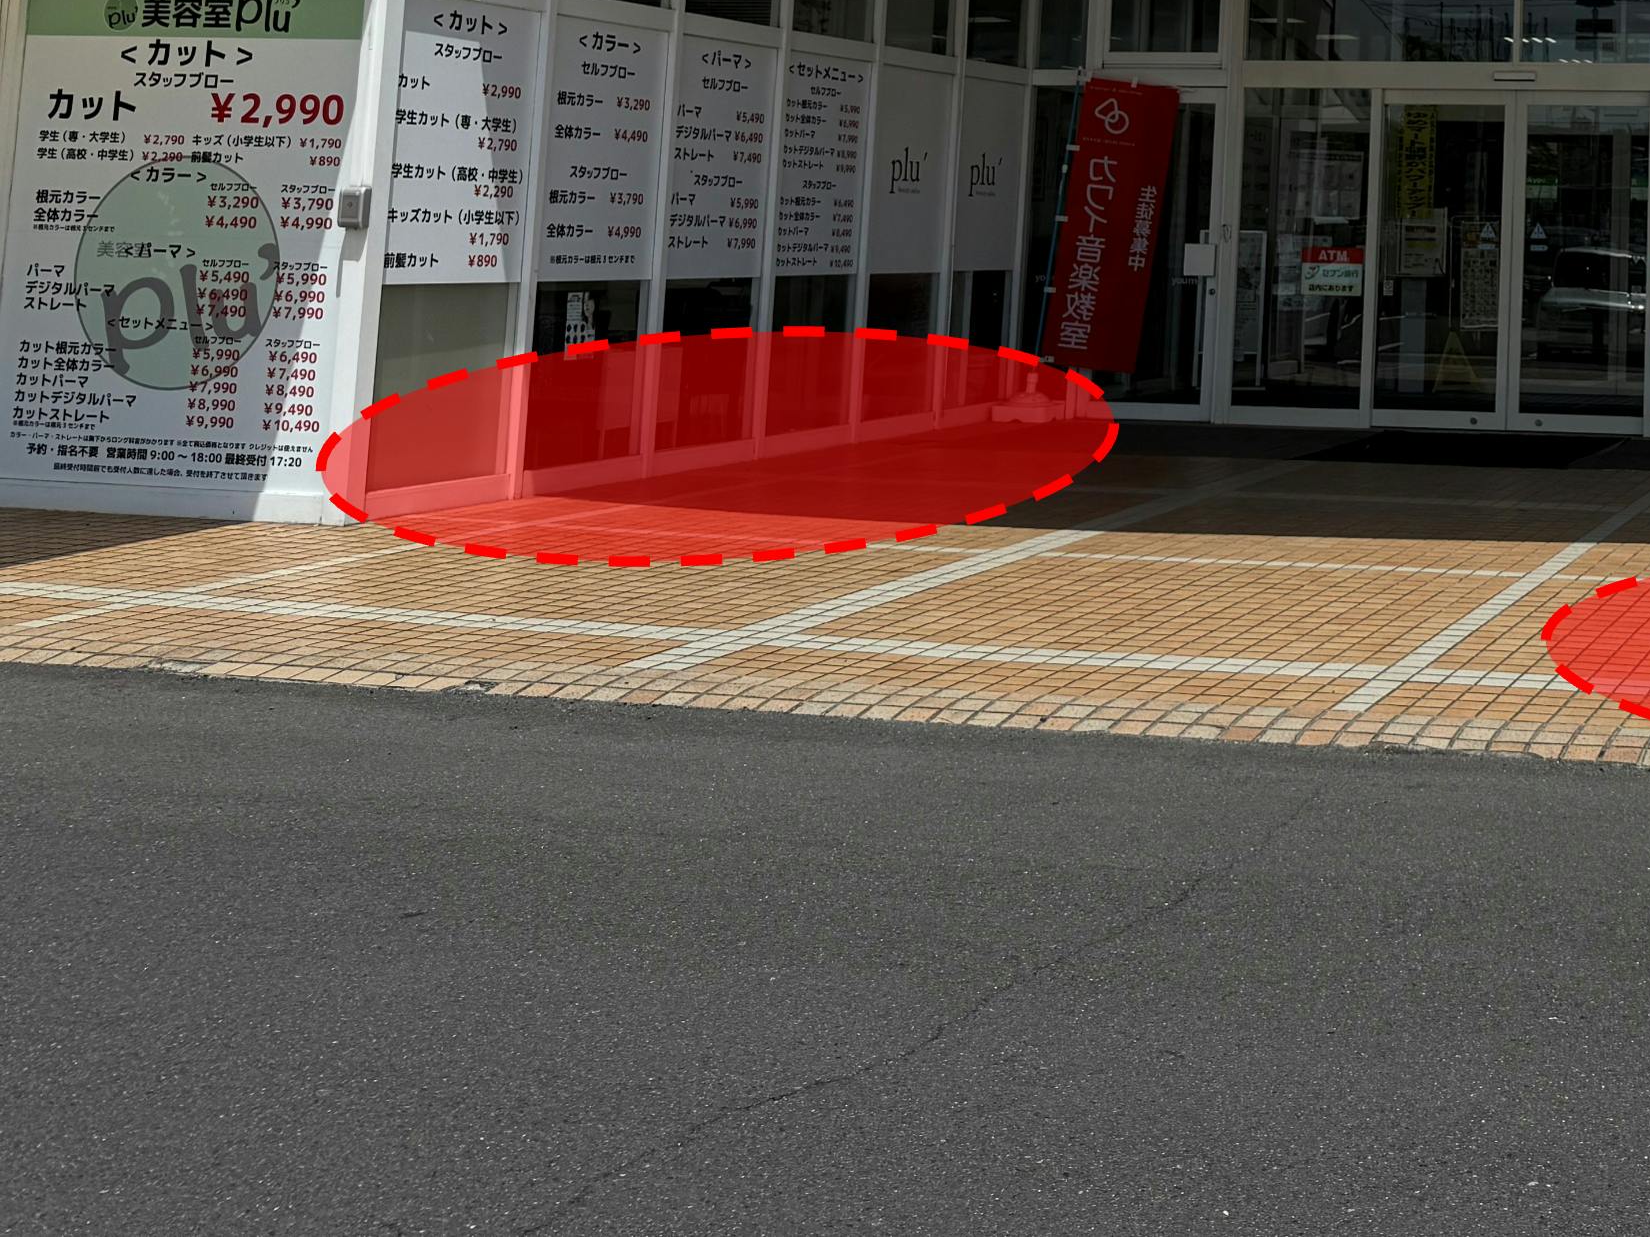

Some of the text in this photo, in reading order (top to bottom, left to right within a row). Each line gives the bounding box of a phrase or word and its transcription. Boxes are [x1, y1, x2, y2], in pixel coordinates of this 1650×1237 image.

[434, 43, 503, 63] スタッフブロー
[581, 61, 636, 79] セルフブロー
[134, 72, 234, 88] スタッフブロー
[398, 73, 522, 99] カット ¥2,990
[702, 76, 749, 92] セルフブロー
[48, 88, 345, 128] カット ¥2,990
[557, 90, 651, 111] 根元カラー ¥3,290
[677, 103, 765, 124] パーマ ¥5,490
[554, 124, 648, 142] 全体カラー ¥4,490
[676, 125, 763, 144] デジタルパーマ ¥6,490
[144, 134, 184, 146] ¥2,790
[299, 137, 342, 150] ¥1,790
[478, 137, 518, 152] ¥2,790
[190, 151, 244, 164] 前髪カット
[309, 156, 340, 167] ¥890
[674, 147, 714, 162] ストレート
[569, 165, 628, 180] スタッフブロー
[210, 182, 335, 194] セルフブロー スタッフブロー
[694, 174, 743, 188] スタッフブロー
[474, 184, 514, 199] ¥2,290
[549, 189, 644, 206] 根元カラー ¥3,790
[671, 192, 696, 206] パーマ
[36, 189, 334, 212] 根元カラー ¥3,290 ¥3,790
[33, 207, 332, 230] 全体カラー ¥4,490 ¥4,990
[670, 213, 726, 228] デジタルパーマ
[546, 223, 642, 239] 全体カラー ¥4,990
[469, 232, 510, 247] ¥1,790
[668, 236, 709, 249] ストレート
[383, 253, 498, 269] 前髪カット ¥890
[1318, 248, 1347, 262] ATM
[202, 259, 328, 272] セルフブロー スタッフブロー
[26, 263, 327, 286] パーマ ¥5,490 ¥5,990
[25, 281, 325, 304] デジタルパーマ ¥6,490 ¥6,990
[24, 297, 323, 320] ストレート ¥7,490 ¥7,990
[266, 338, 320, 349] スタッフブロー
[19, 340, 318, 364] カット根元カラー ¥5,990 ¥6,490
[18, 356, 316, 381] カット全体カラー ¥6,990 ¥7,490
[16, 373, 314, 398] カットパーマ ¥7,990 ¥8,490
[14, 390, 313, 416] カットデジタルパーマ ¥8,990 ¥9,490
[13, 406, 319, 433] カットストレート ¥9,990 ¥10,490
[270, 456, 302, 467] 17:20
